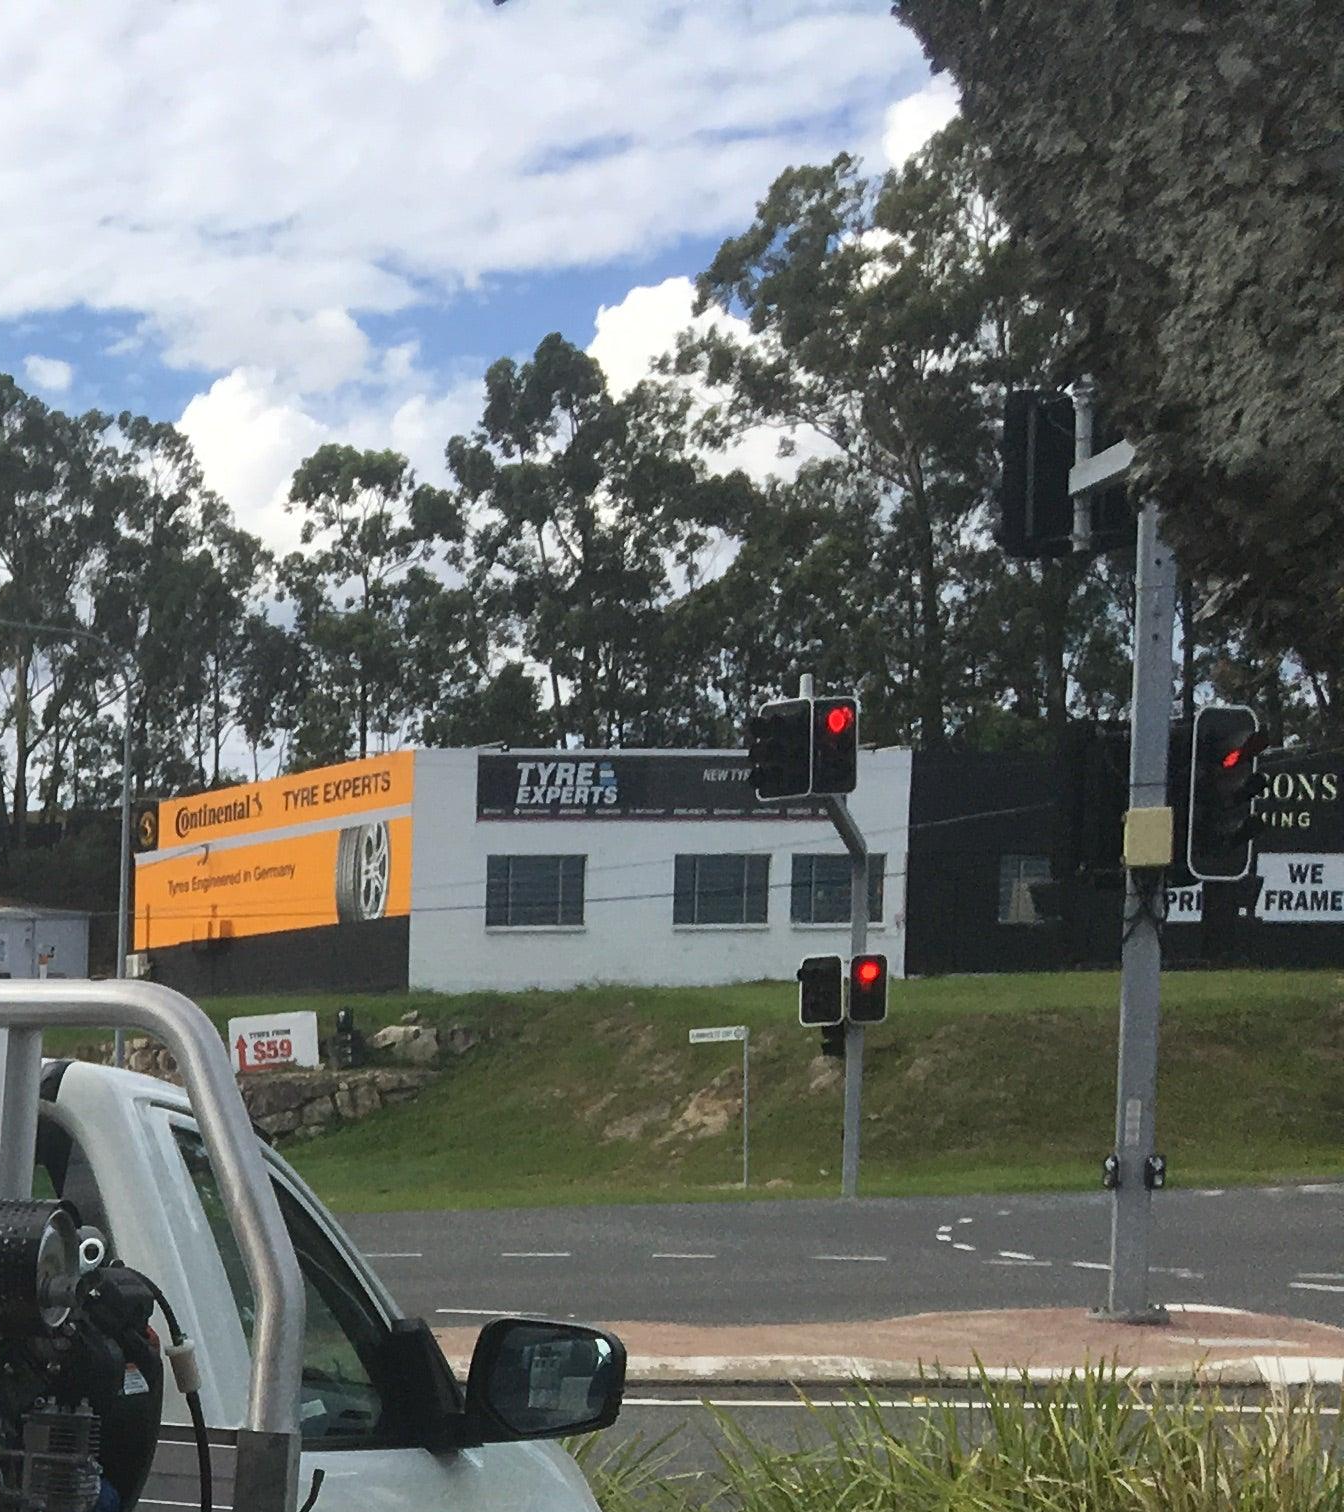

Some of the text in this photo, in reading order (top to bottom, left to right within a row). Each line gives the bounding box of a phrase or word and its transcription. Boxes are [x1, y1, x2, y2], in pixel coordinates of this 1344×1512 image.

[516, 762, 596, 786] TYRE
[702, 768, 730, 783] NEW
[175, 770, 392, 839] Continental TYRE EXPERTS
[515, 786, 619, 805] EXPERTS
[167, 862, 297, 898] Tyres Engineered in Germany
[1287, 862, 1324, 885] WE
[1263, 889, 1344, 912] FRAME
[253, 1038, 292, 1061] $59
